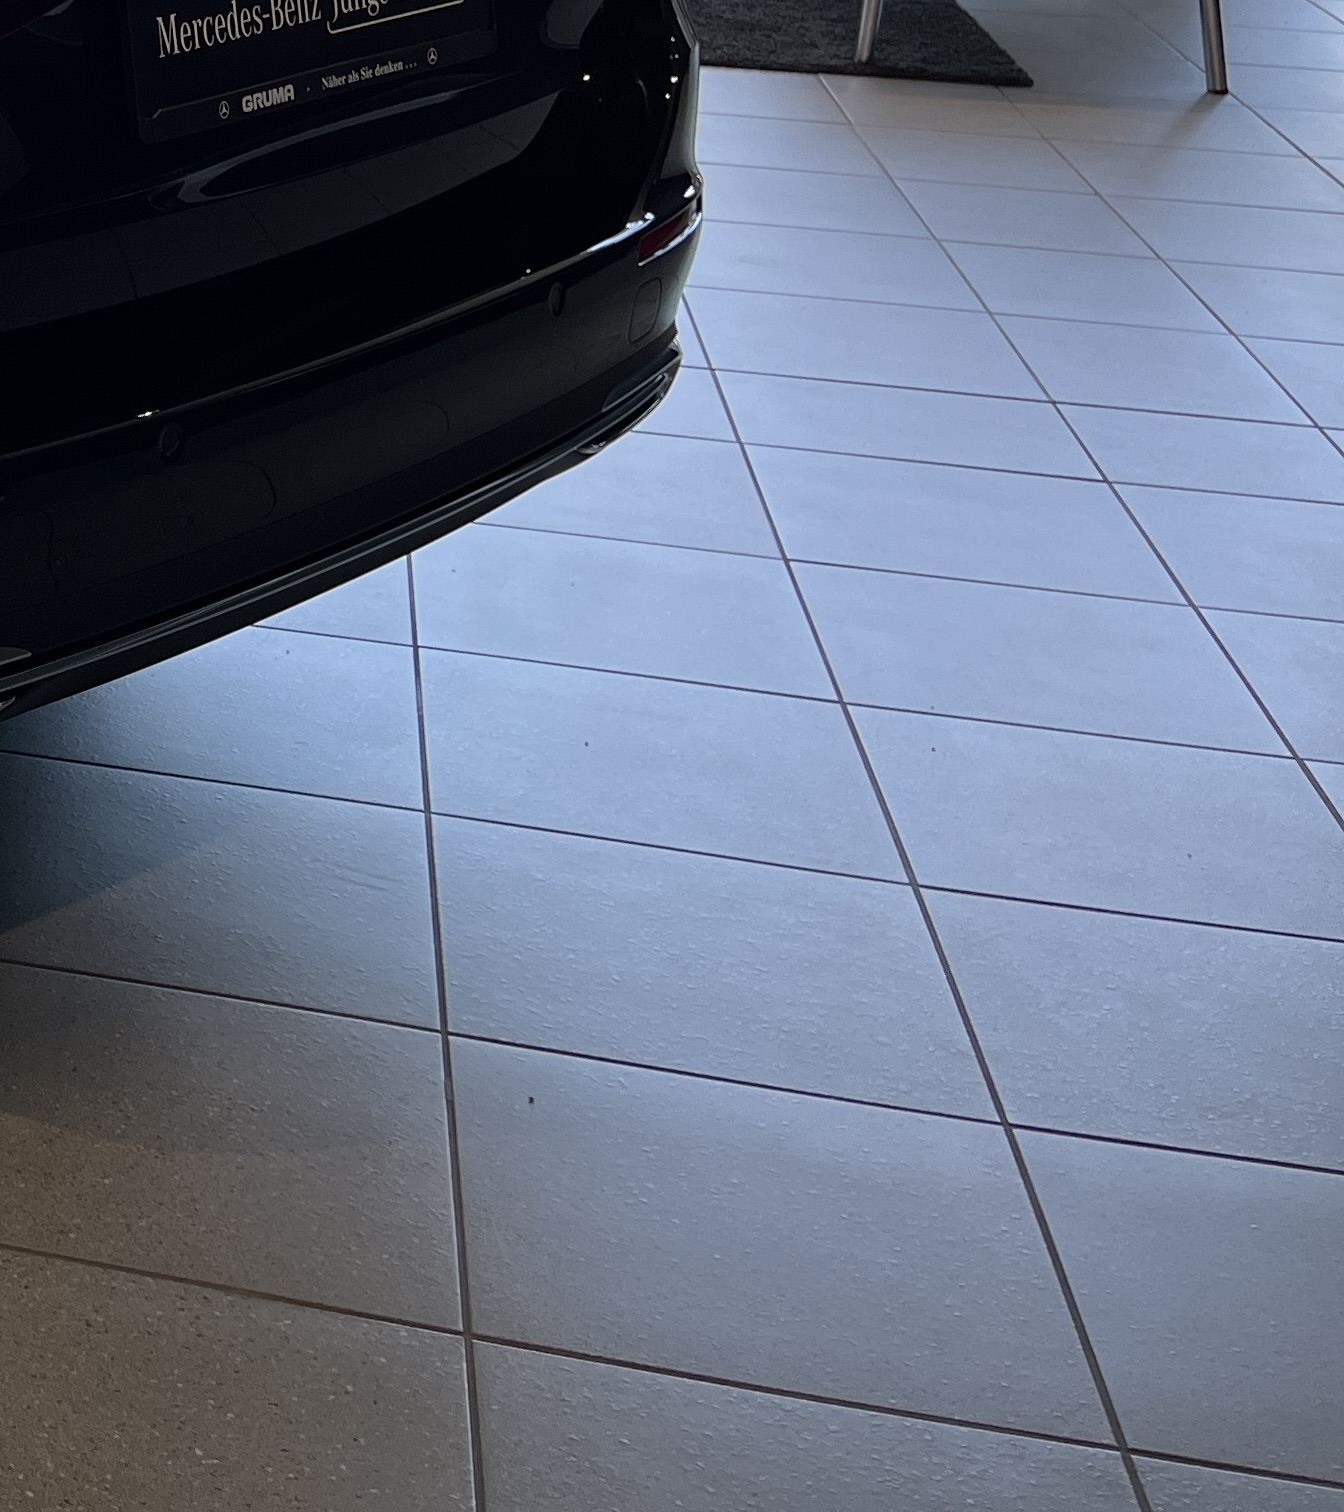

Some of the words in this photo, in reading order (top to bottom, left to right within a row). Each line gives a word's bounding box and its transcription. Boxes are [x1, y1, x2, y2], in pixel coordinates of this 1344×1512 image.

[242, 84, 295, 113] GRUMA
[322, 75, 346, 90] Näher
[348, 70, 359, 83] als
[361, 66, 373, 80] Sie
